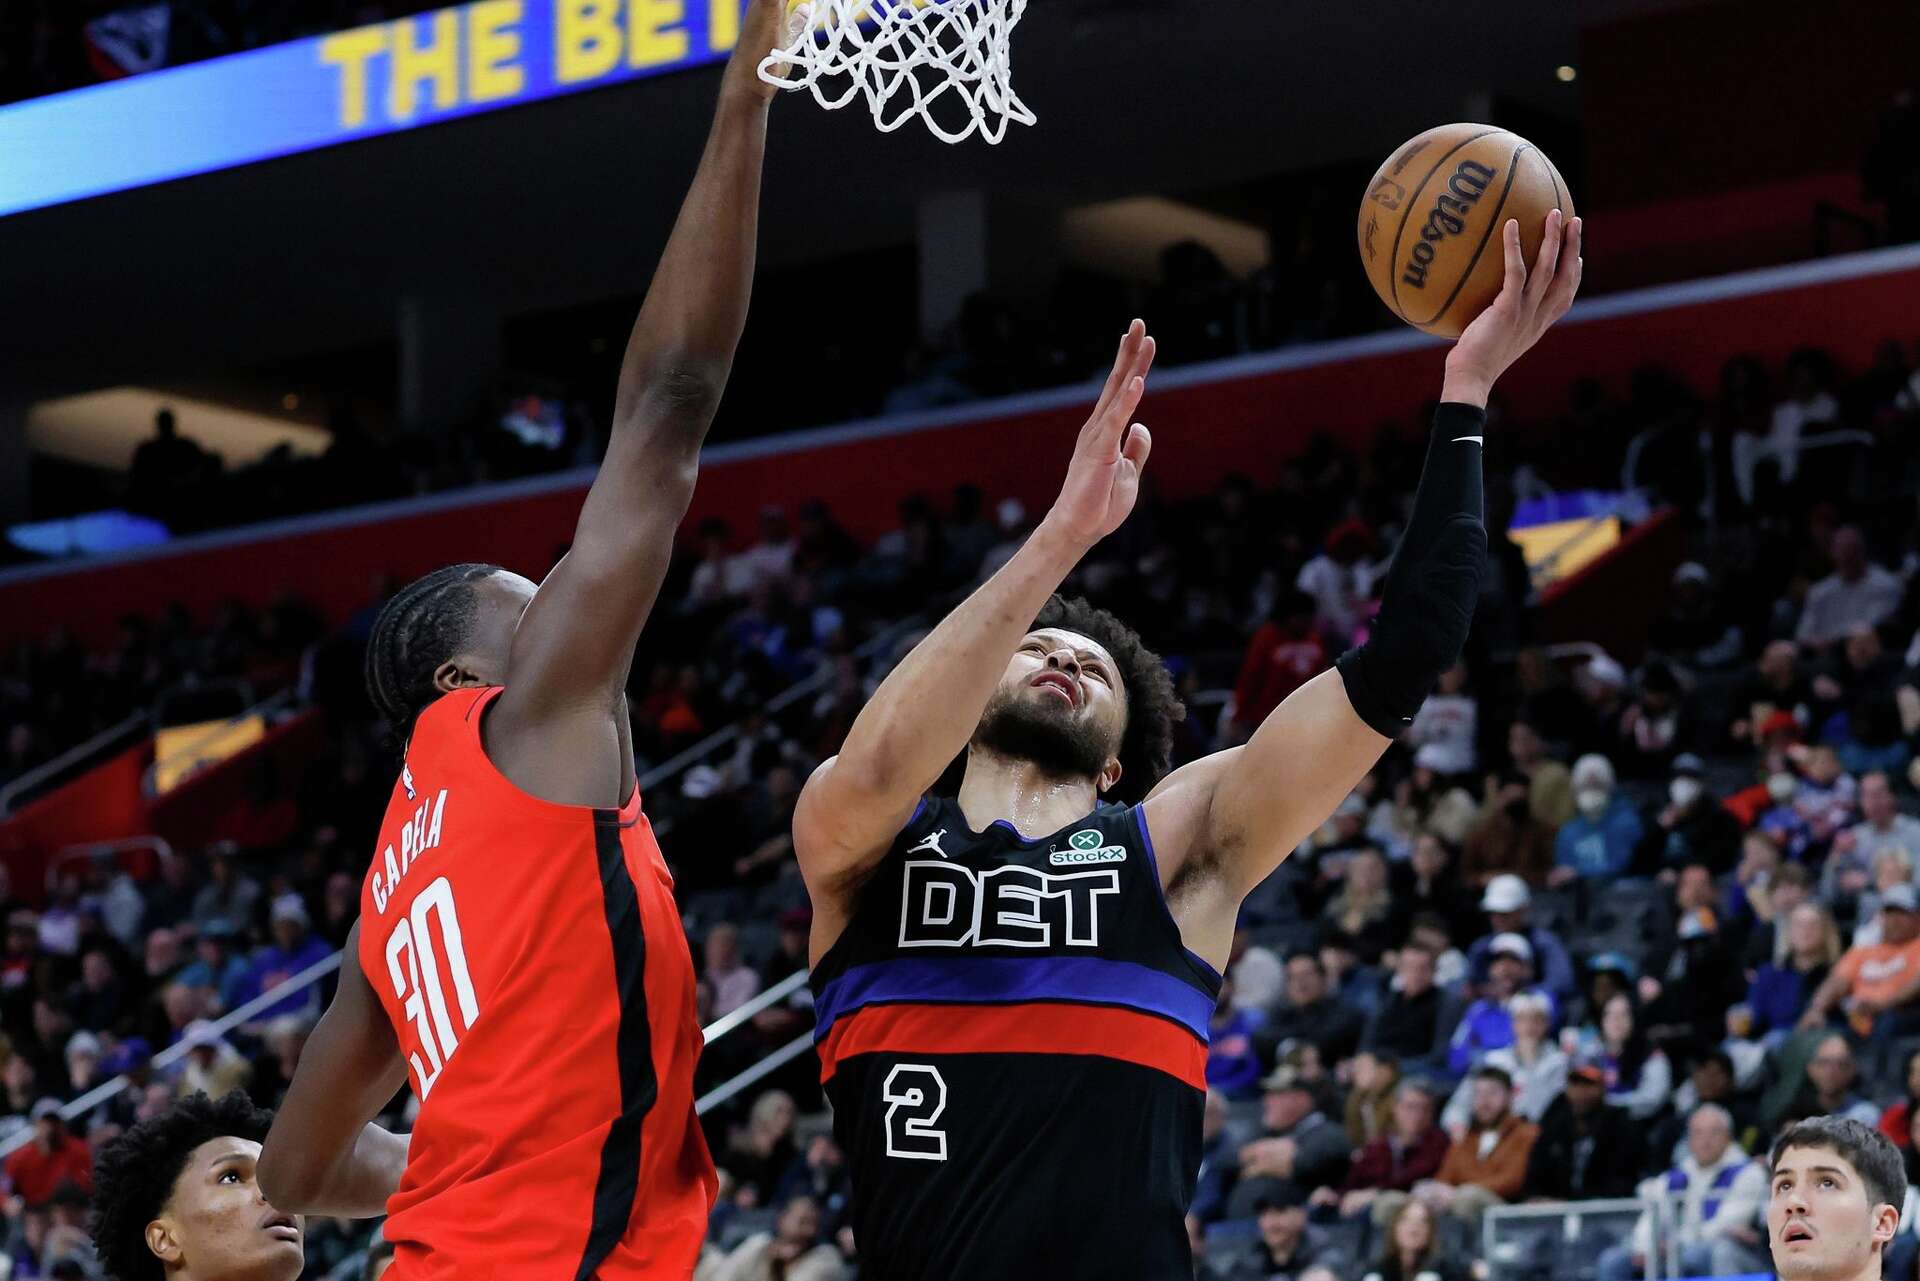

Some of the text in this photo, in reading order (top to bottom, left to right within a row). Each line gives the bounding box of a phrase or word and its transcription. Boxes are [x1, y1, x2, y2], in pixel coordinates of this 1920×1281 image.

[321, 2, 522, 127] THE
[1403, 161, 1496, 288] Wilson
[371, 789, 448, 915] CAPELA
[898, 861, 1120, 947] DET
[385, 876, 480, 1102] 30
[883, 1063, 947, 1161] 2
